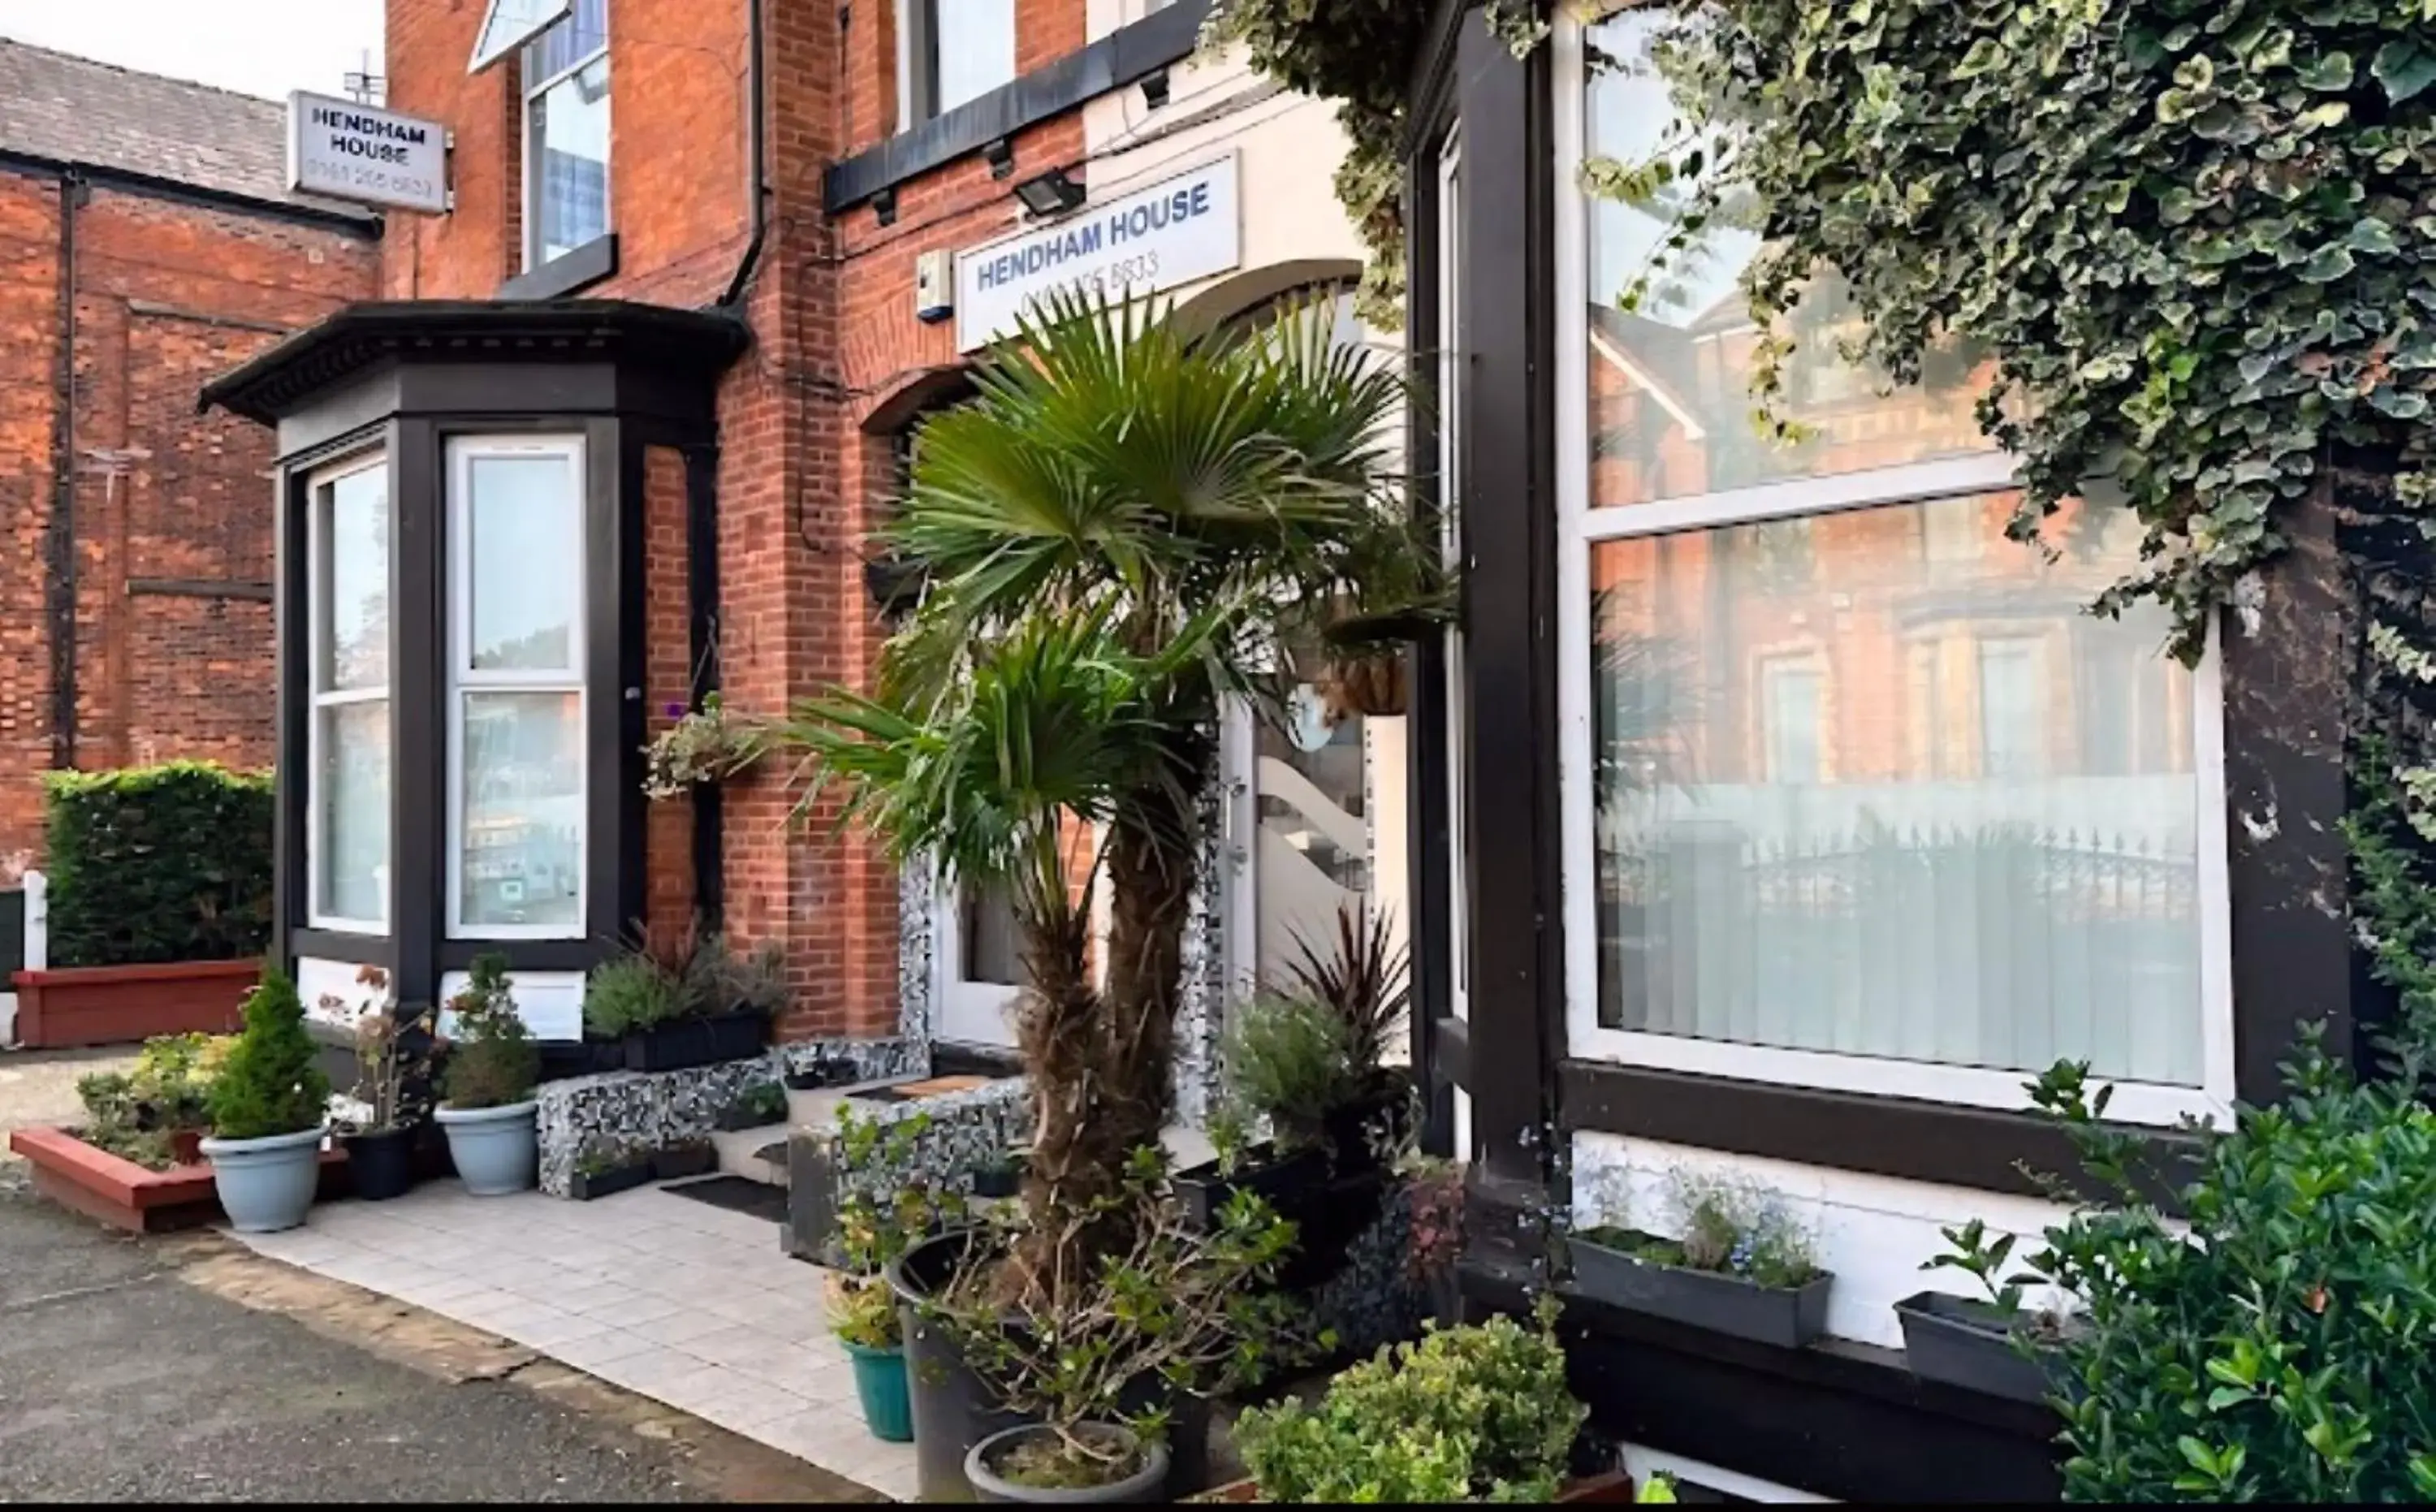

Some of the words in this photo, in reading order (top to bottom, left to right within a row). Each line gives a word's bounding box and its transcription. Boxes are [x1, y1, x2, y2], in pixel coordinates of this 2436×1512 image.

[312, 108, 425, 144] HENDHAM
[330, 134, 409, 166] HOUSE
[978, 222, 1101, 291] HENDHAM
[1111, 181, 1210, 245] HOUSE
